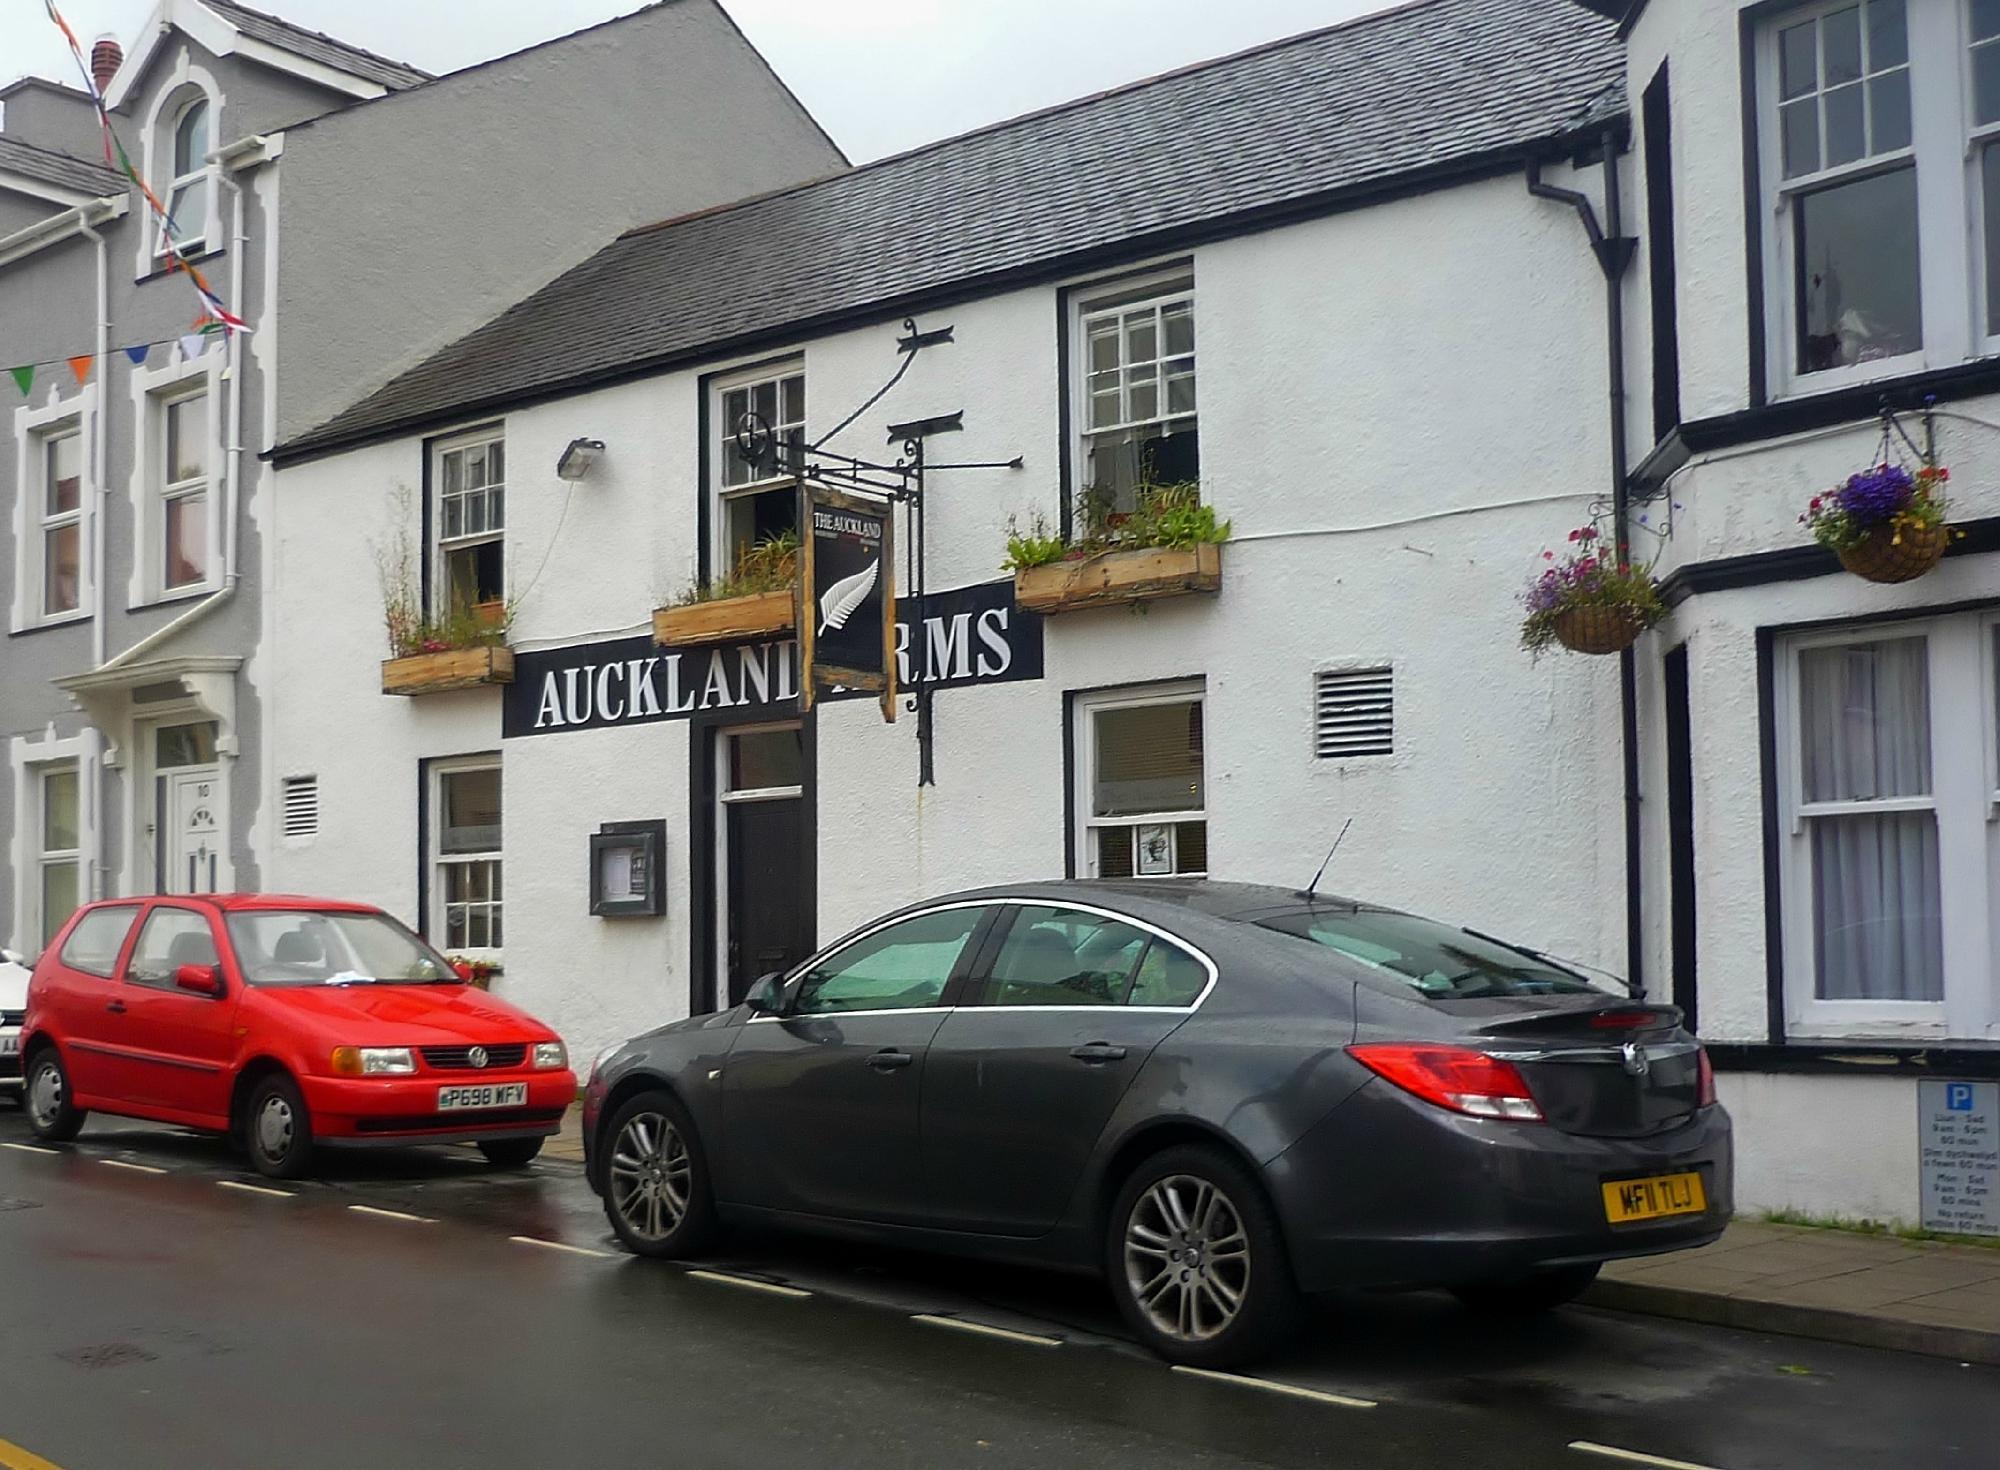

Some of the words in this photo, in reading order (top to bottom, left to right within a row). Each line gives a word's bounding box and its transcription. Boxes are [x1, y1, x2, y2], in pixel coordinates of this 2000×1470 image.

[813, 511, 833, 530] THE
[833, 516, 881, 539] AUCKLAND
[448, 1087, 491, 1106] P698
[1953, 1086, 1969, 1108] P
[1659, 1179, 1692, 1209] TLJ
